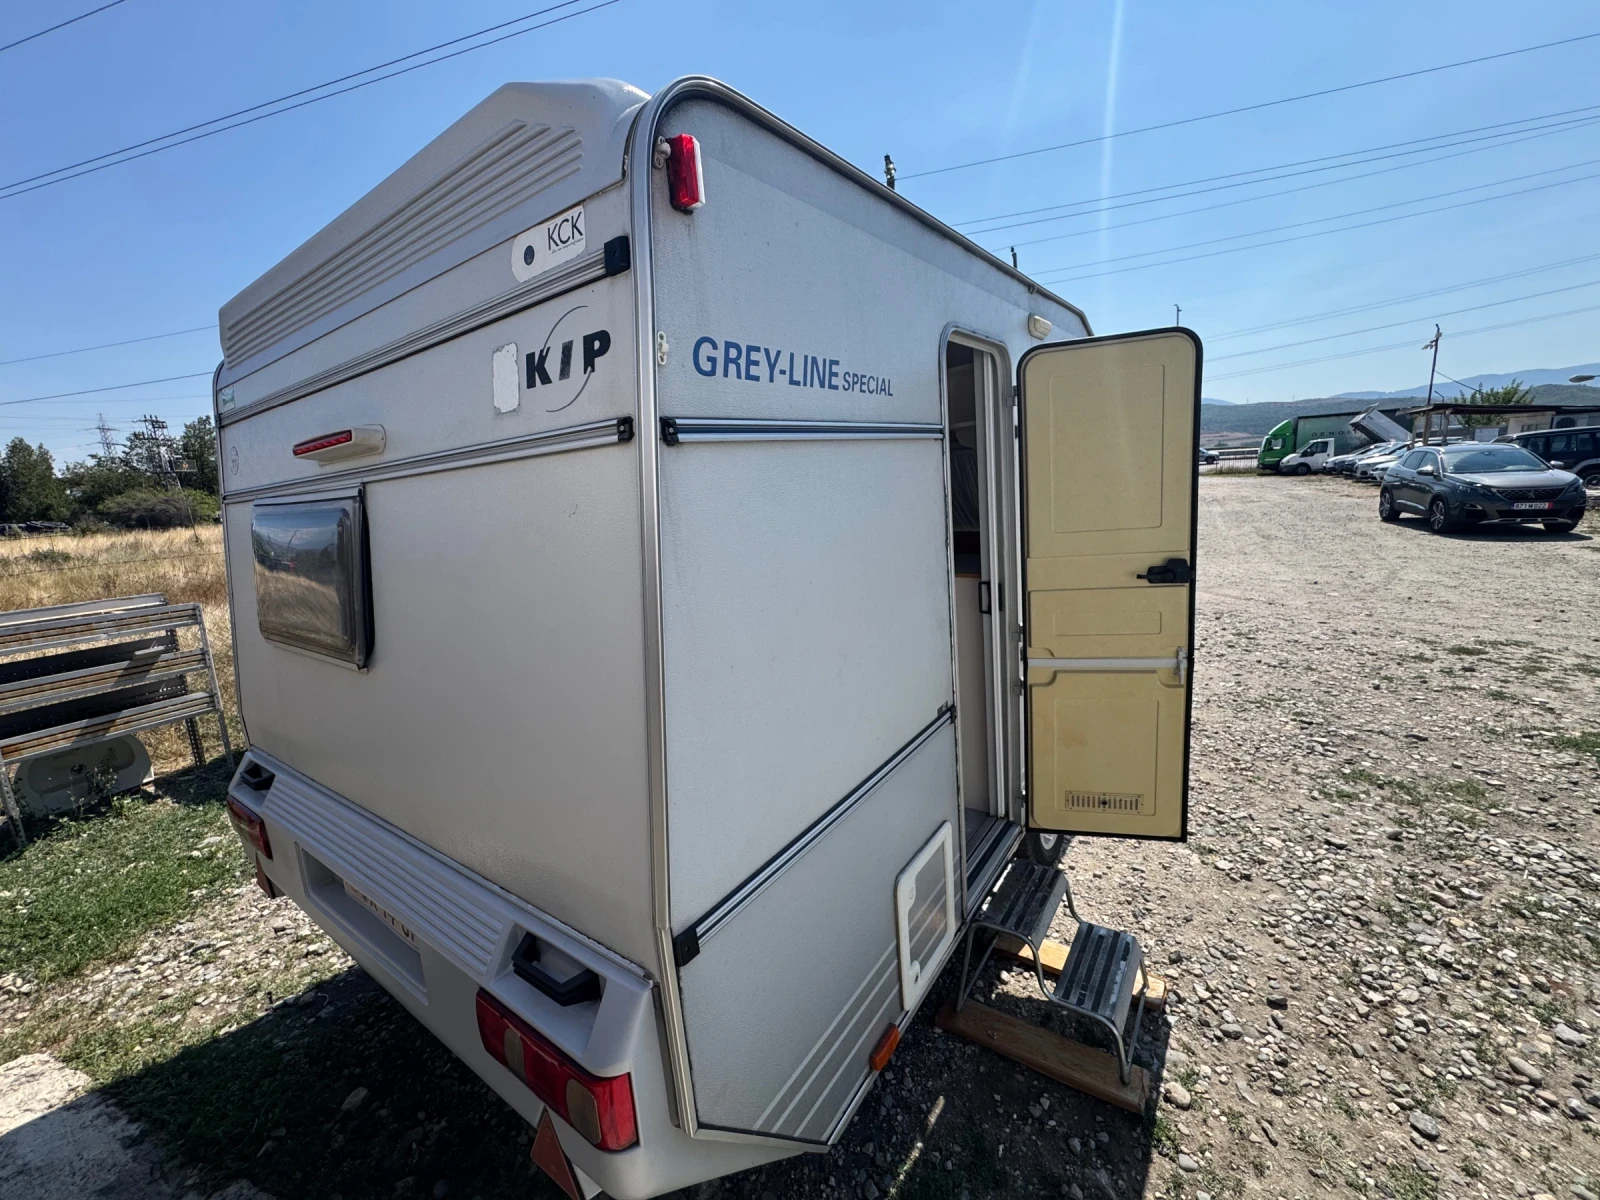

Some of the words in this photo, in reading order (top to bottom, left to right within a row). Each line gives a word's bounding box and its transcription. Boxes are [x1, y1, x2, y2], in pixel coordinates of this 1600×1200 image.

[547, 211, 584, 251] KCK
[525, 329, 612, 390] KIP
[692, 336, 840, 390] GREY-LINE
[842, 371, 894, 397] SPECIAL
